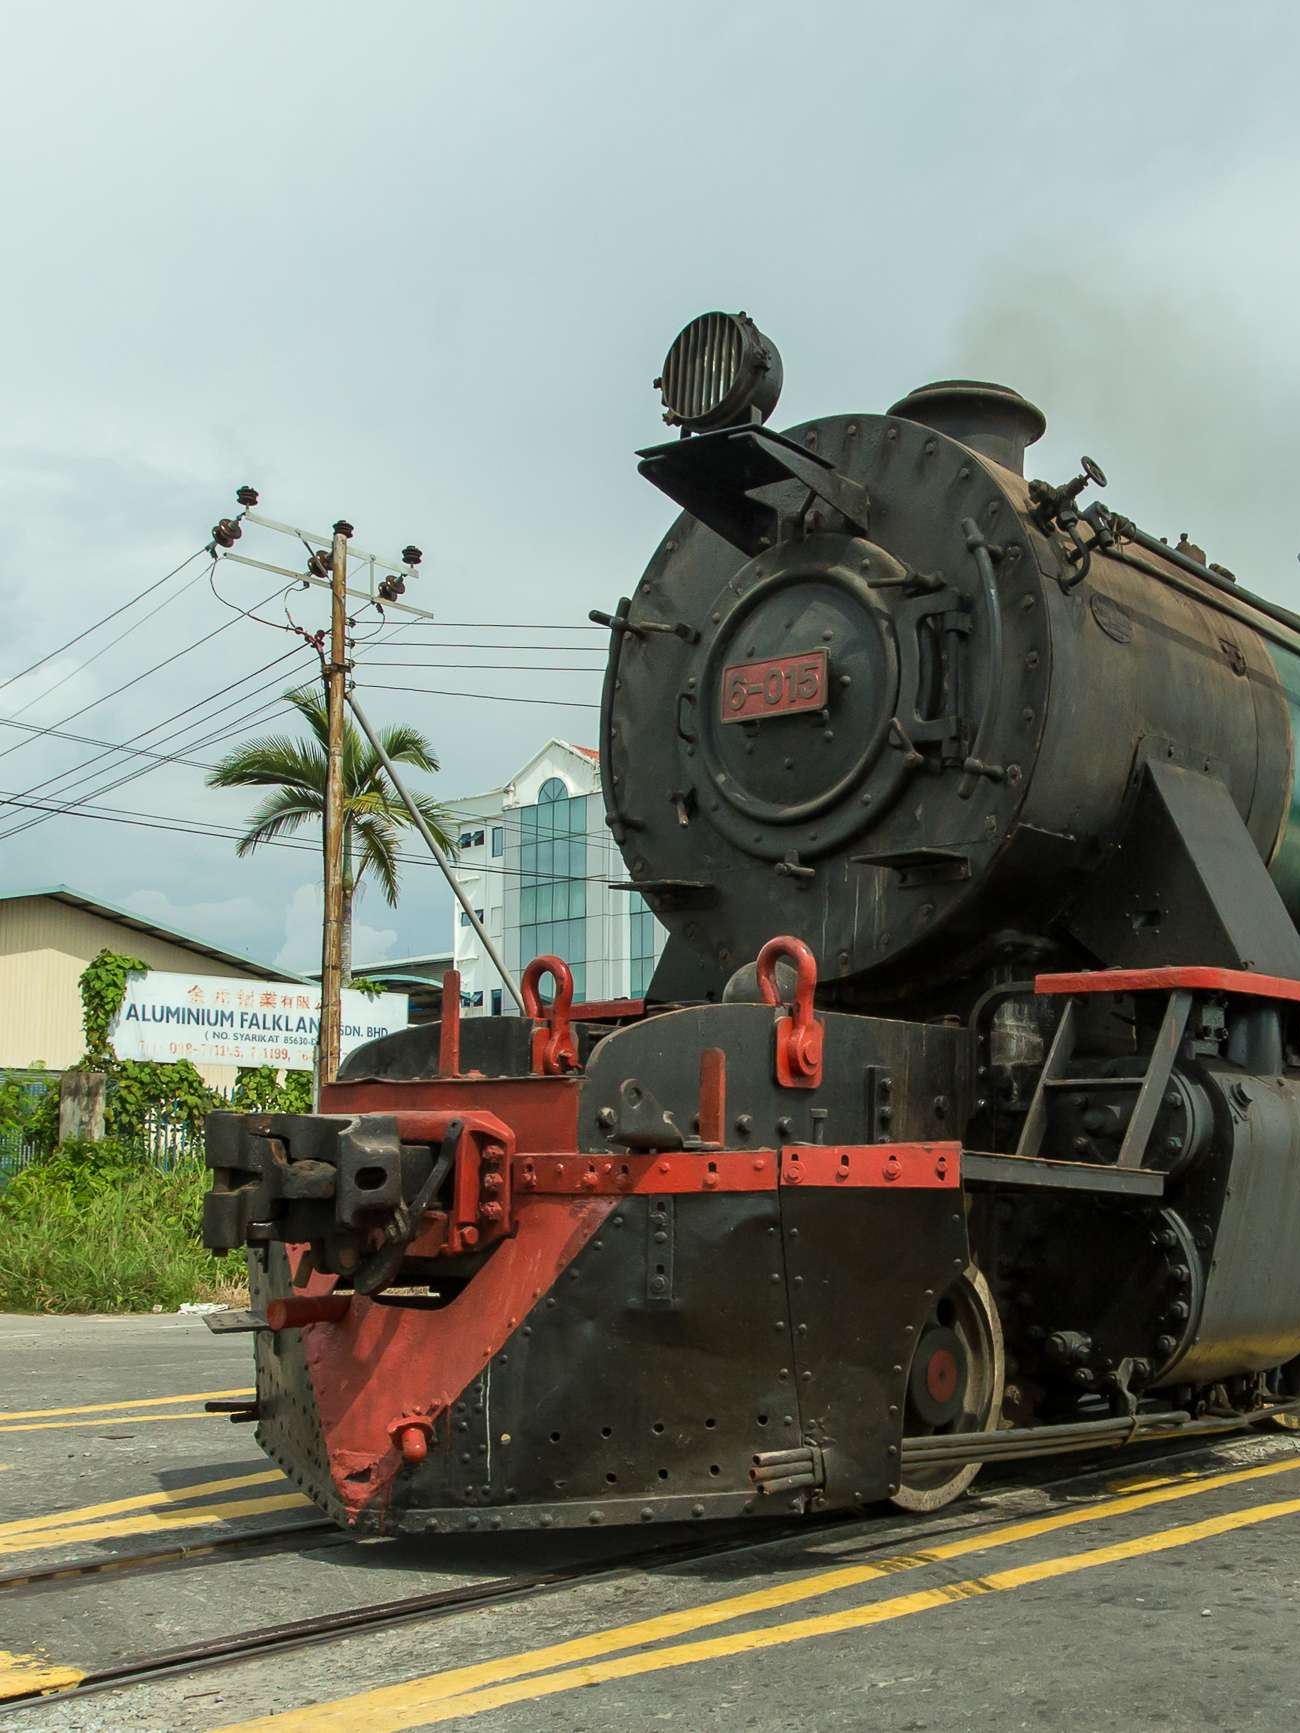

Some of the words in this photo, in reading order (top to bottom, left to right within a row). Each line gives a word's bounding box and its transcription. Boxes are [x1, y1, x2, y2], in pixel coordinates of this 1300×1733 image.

[727, 662, 819, 711] 6-015
[125, 1003, 234, 1028] ALUMINIUM
[240, 1011, 320, 1034] FALKLAN
[233, 1032, 280, 1043] SYARIKAT
